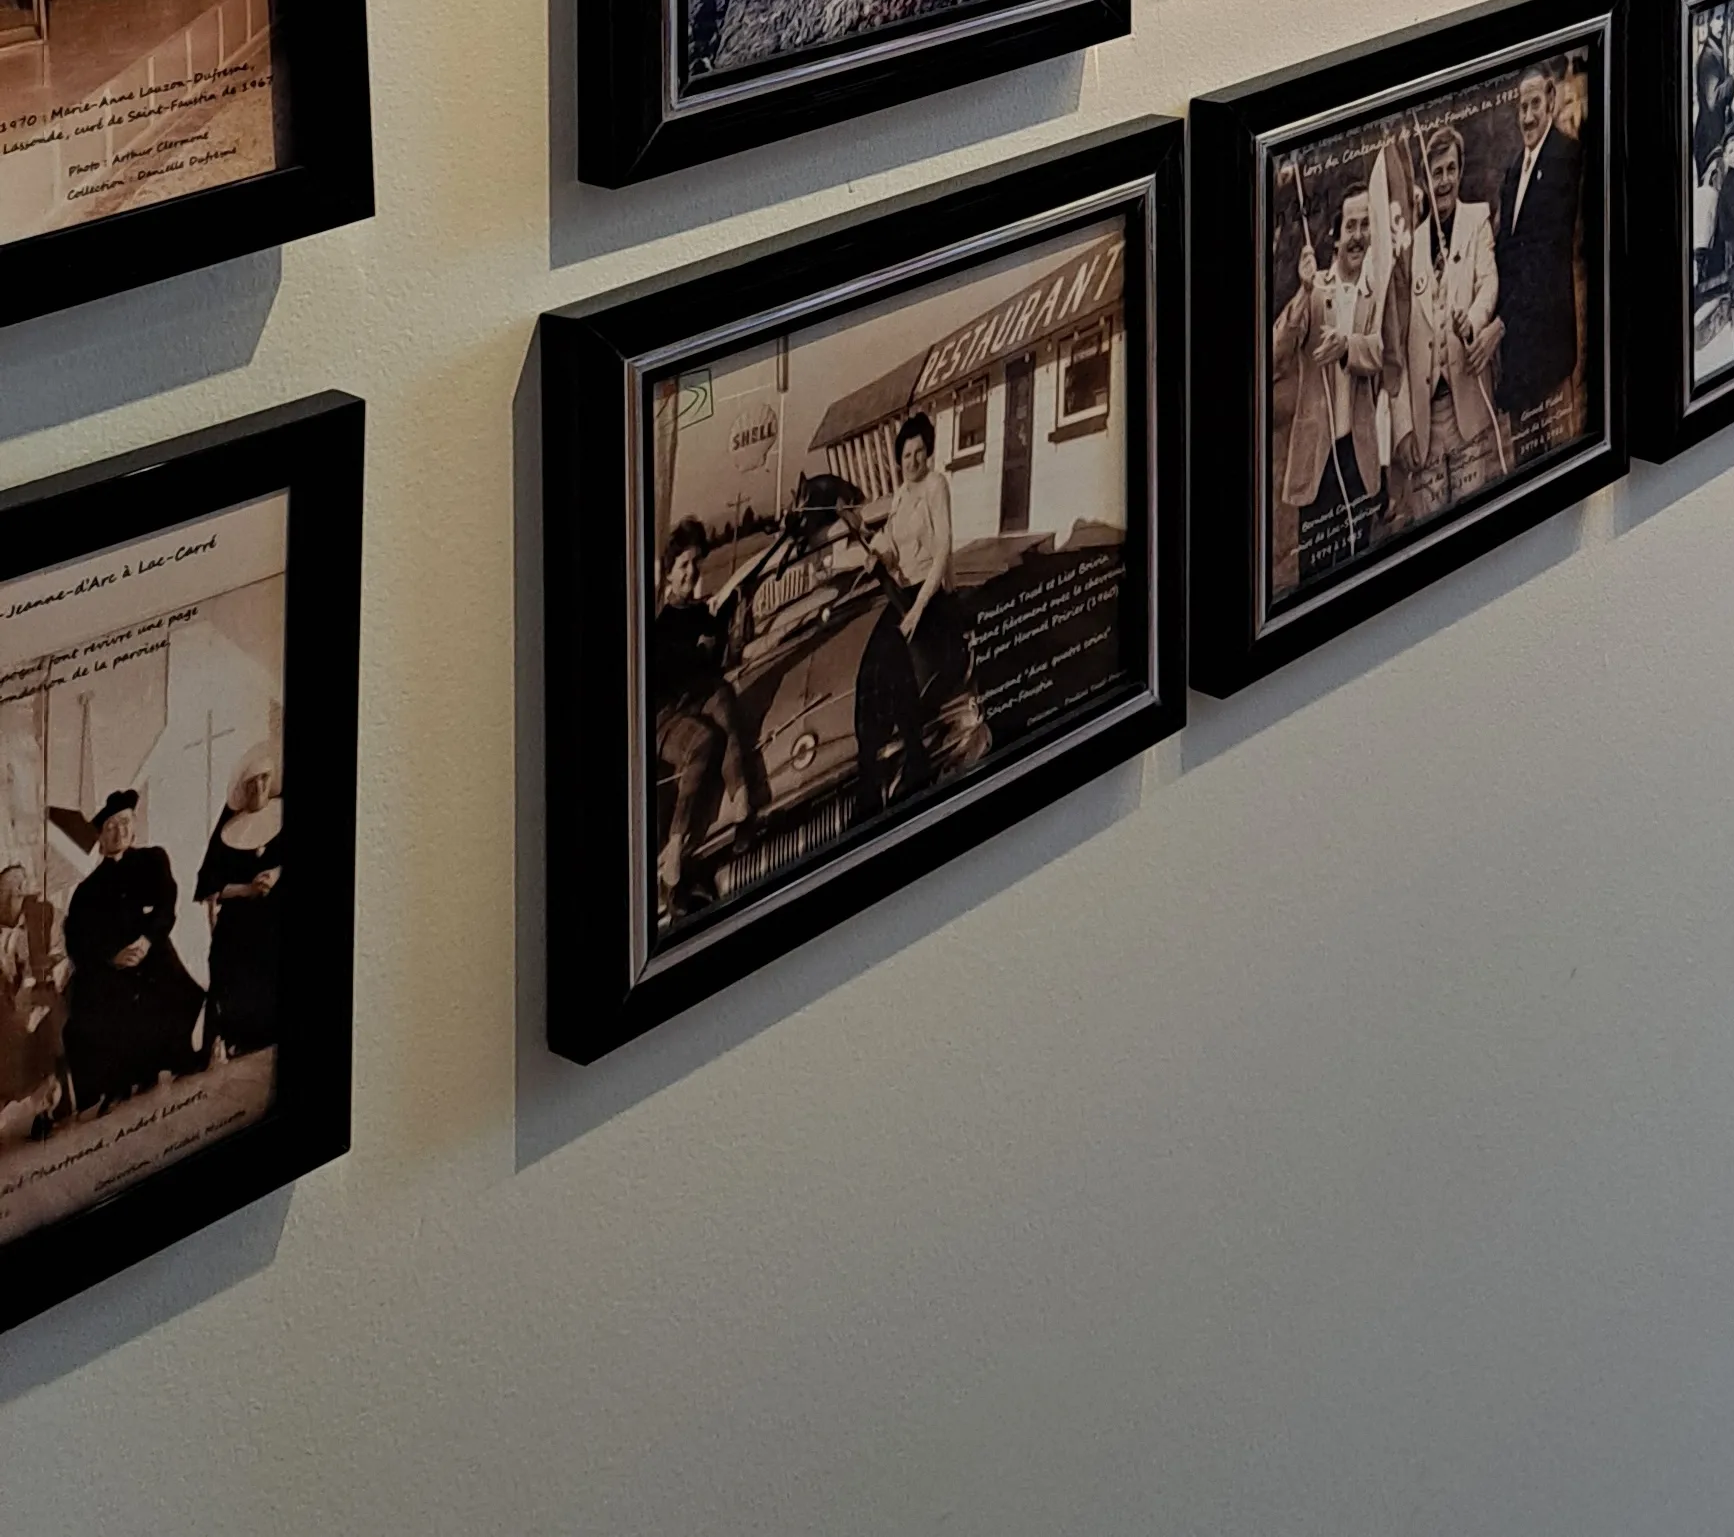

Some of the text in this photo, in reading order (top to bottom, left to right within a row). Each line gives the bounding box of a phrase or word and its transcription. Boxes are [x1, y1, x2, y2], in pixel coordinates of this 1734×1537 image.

[0, 61, 256, 134] 1970 Marie-Anne Lauzon-Dufresne,
[2, 129, 70, 156] Lassonde,
[74, 119, 104, 137] curé
[107, 113, 124, 127] de
[127, 91, 217, 123] Saint-Faustin
[221, 84, 238, 98] de
[66, 178, 125, 202] Collection
[188, 145, 238, 169] Dufresne
[68, 130, 211, 177] Photo Arthur Clermont
[914, 239, 1126, 394] RESTAURANT
[731, 420, 777, 452] SHELL
[121, 564, 132, 579] à
[138, 533, 220, 575] Lac-Carré
[83, 629, 133, 656] revivre
[138, 617, 165, 635] une
[167, 606, 200, 629] page
[976, 597, 1016, 625] Pauline
[72, 658, 108, 681] de la
